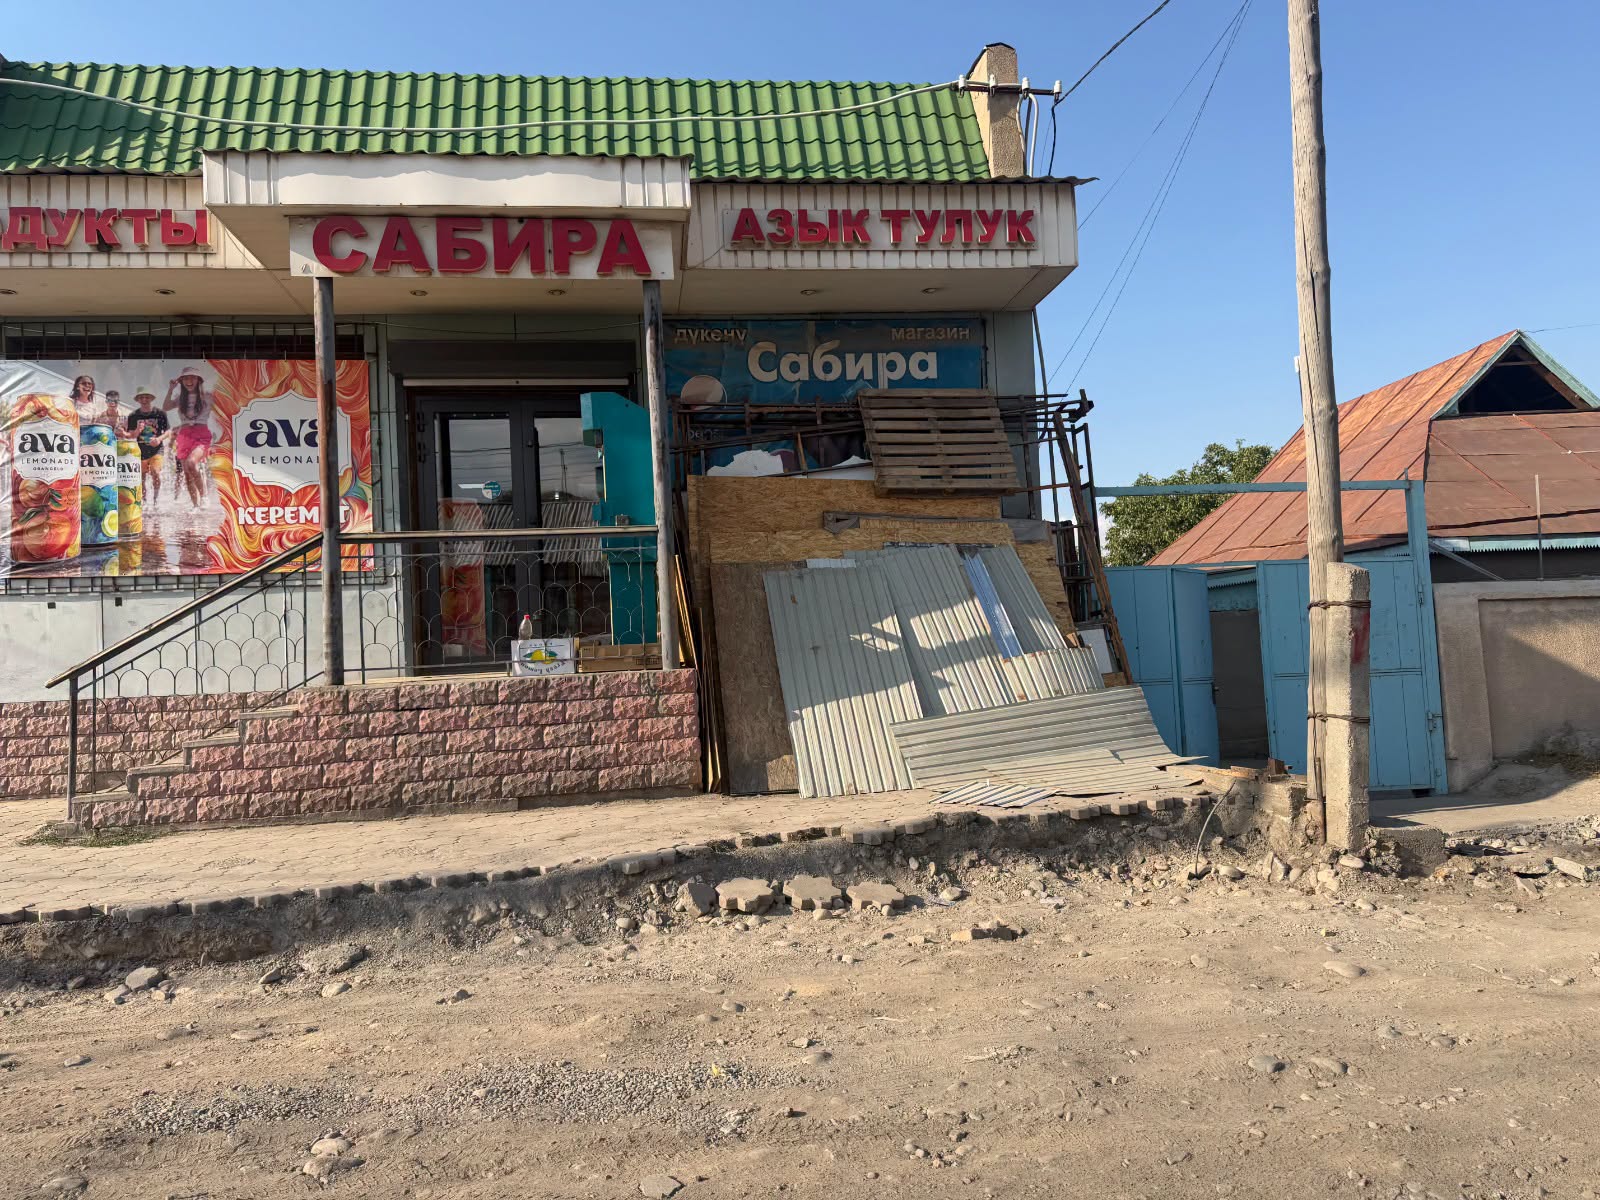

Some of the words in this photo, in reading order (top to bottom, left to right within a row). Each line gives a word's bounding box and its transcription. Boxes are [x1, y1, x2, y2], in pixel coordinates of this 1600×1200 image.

[0, 206, 211, 250] ДУКТЫ
[730, 207, 873, 245] АЗЫК
[880, 208, 1037, 245] ТУЛУК
[312, 215, 653, 276] САБИРА
[890, 326, 971, 342] магазин
[747, 339, 939, 390] Сабира
[18, 433, 76, 455] ava
[21, 457, 74, 465] LEMONADE
[80, 453, 116, 468] ava
[117, 462, 141, 473] ava
[251, 455, 320, 465] LEMONA
[236, 505, 350, 526] КЕРЕМТ
